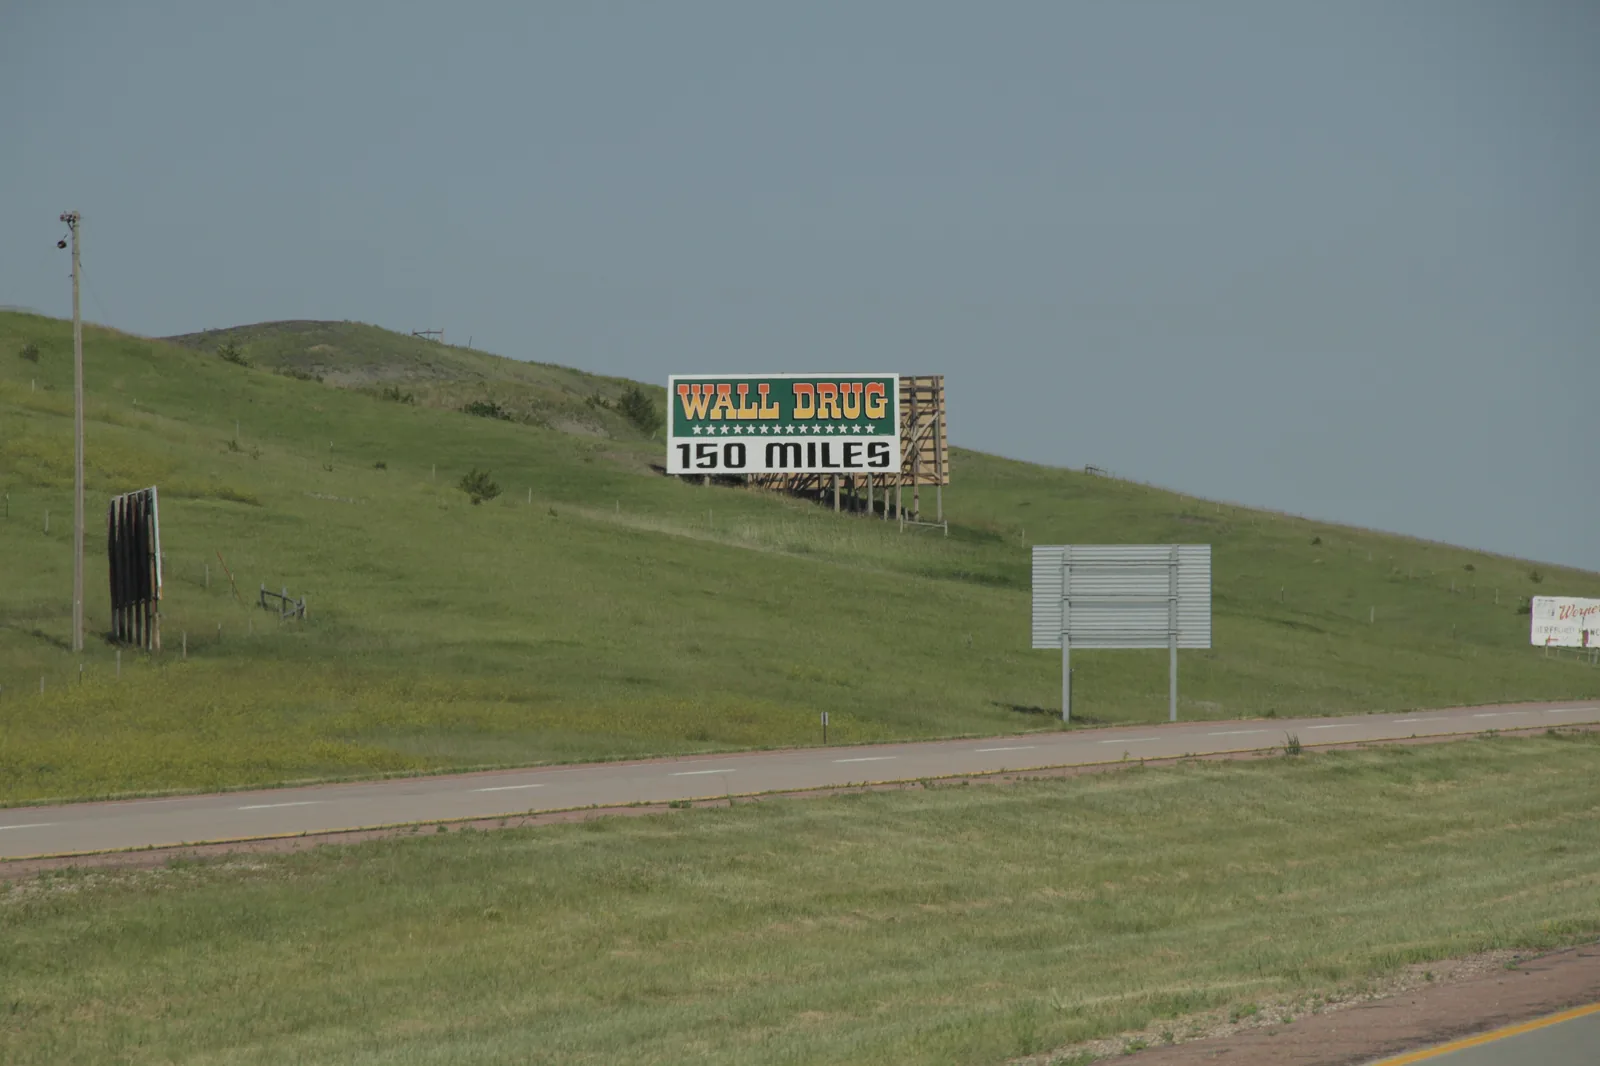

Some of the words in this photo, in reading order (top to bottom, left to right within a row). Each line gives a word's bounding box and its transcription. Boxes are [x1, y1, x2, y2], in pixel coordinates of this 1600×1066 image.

[677, 383, 780, 420] WALL
[792, 382, 888, 420] DRUG
[676, 442, 747, 469] 150
[765, 441, 891, 469] MILES
